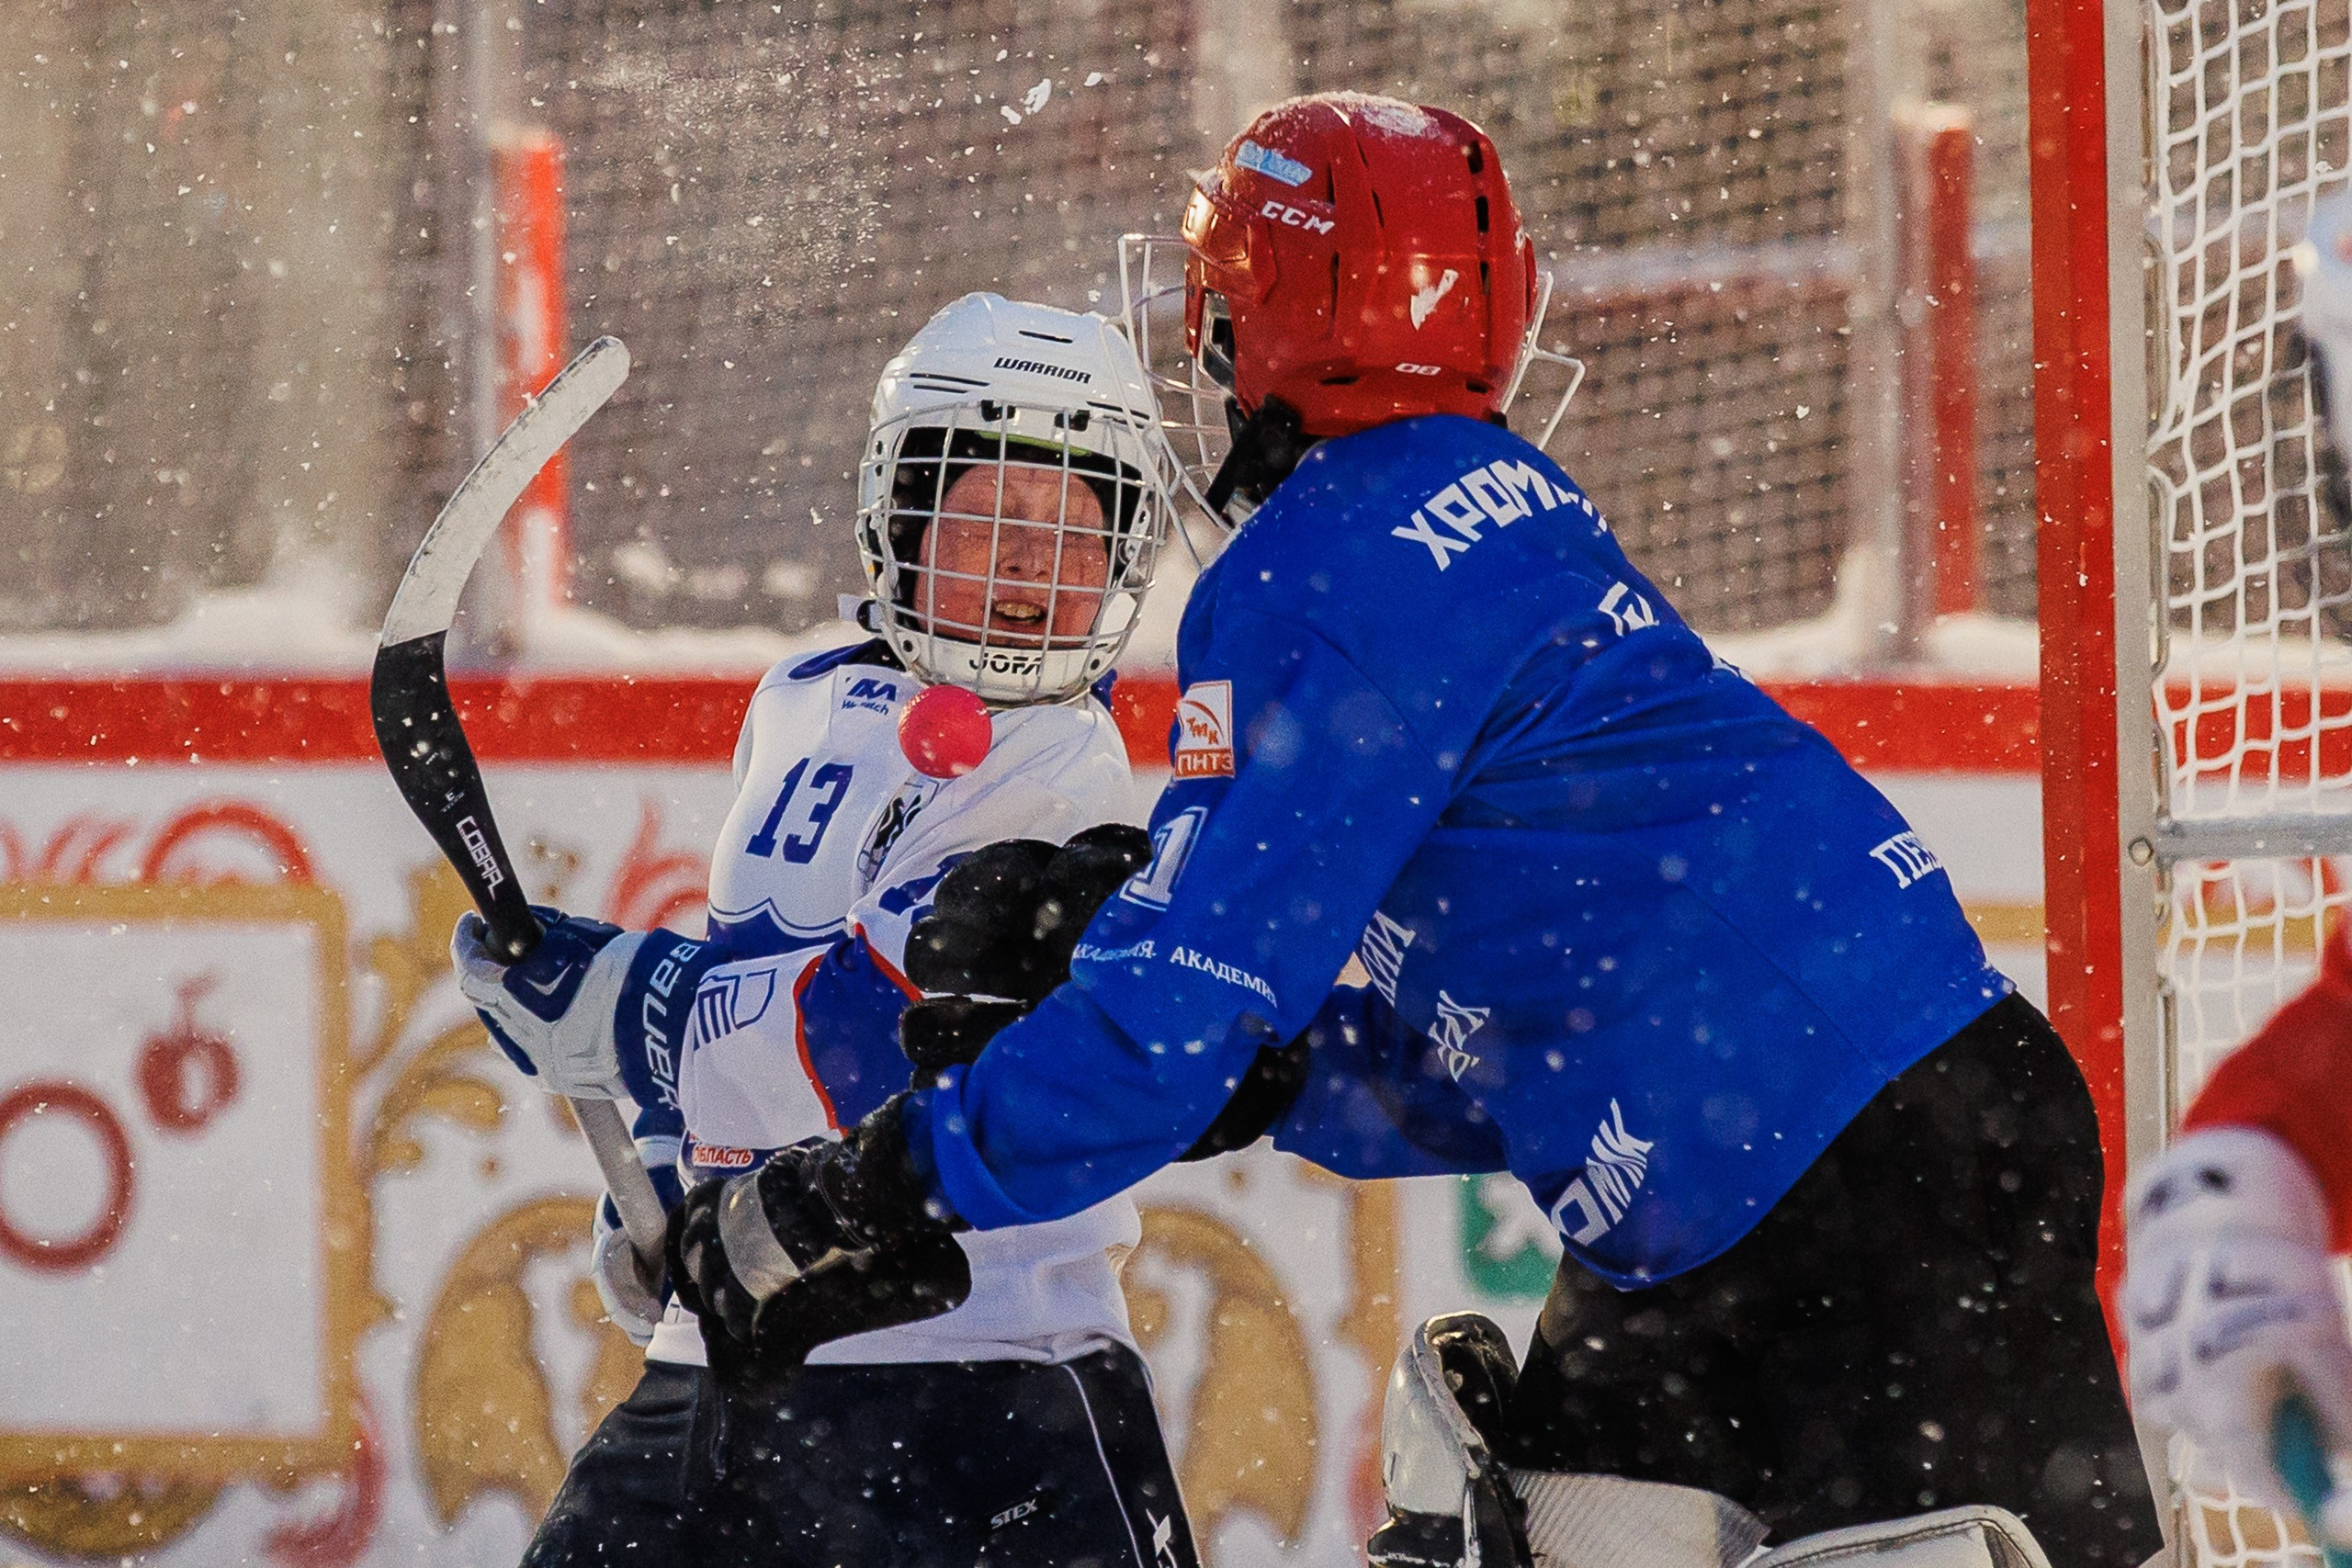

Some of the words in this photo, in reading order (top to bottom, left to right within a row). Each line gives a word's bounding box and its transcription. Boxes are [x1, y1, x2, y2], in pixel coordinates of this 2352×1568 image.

[1261, 199, 1335, 235] CCM
[993, 356, 1091, 385] WARRIOR
[1390, 458, 1608, 572] ХРОМ
[968, 652, 1043, 676] JOFA
[1177, 752, 1232, 774] ПНТЗ
[744, 757, 854, 864] 13
[456, 815, 504, 902] COBRA
[1121, 806, 1208, 912] 1
[1868, 829, 1943, 890] ПЕ
[642, 941, 705, 1109] BAUER
